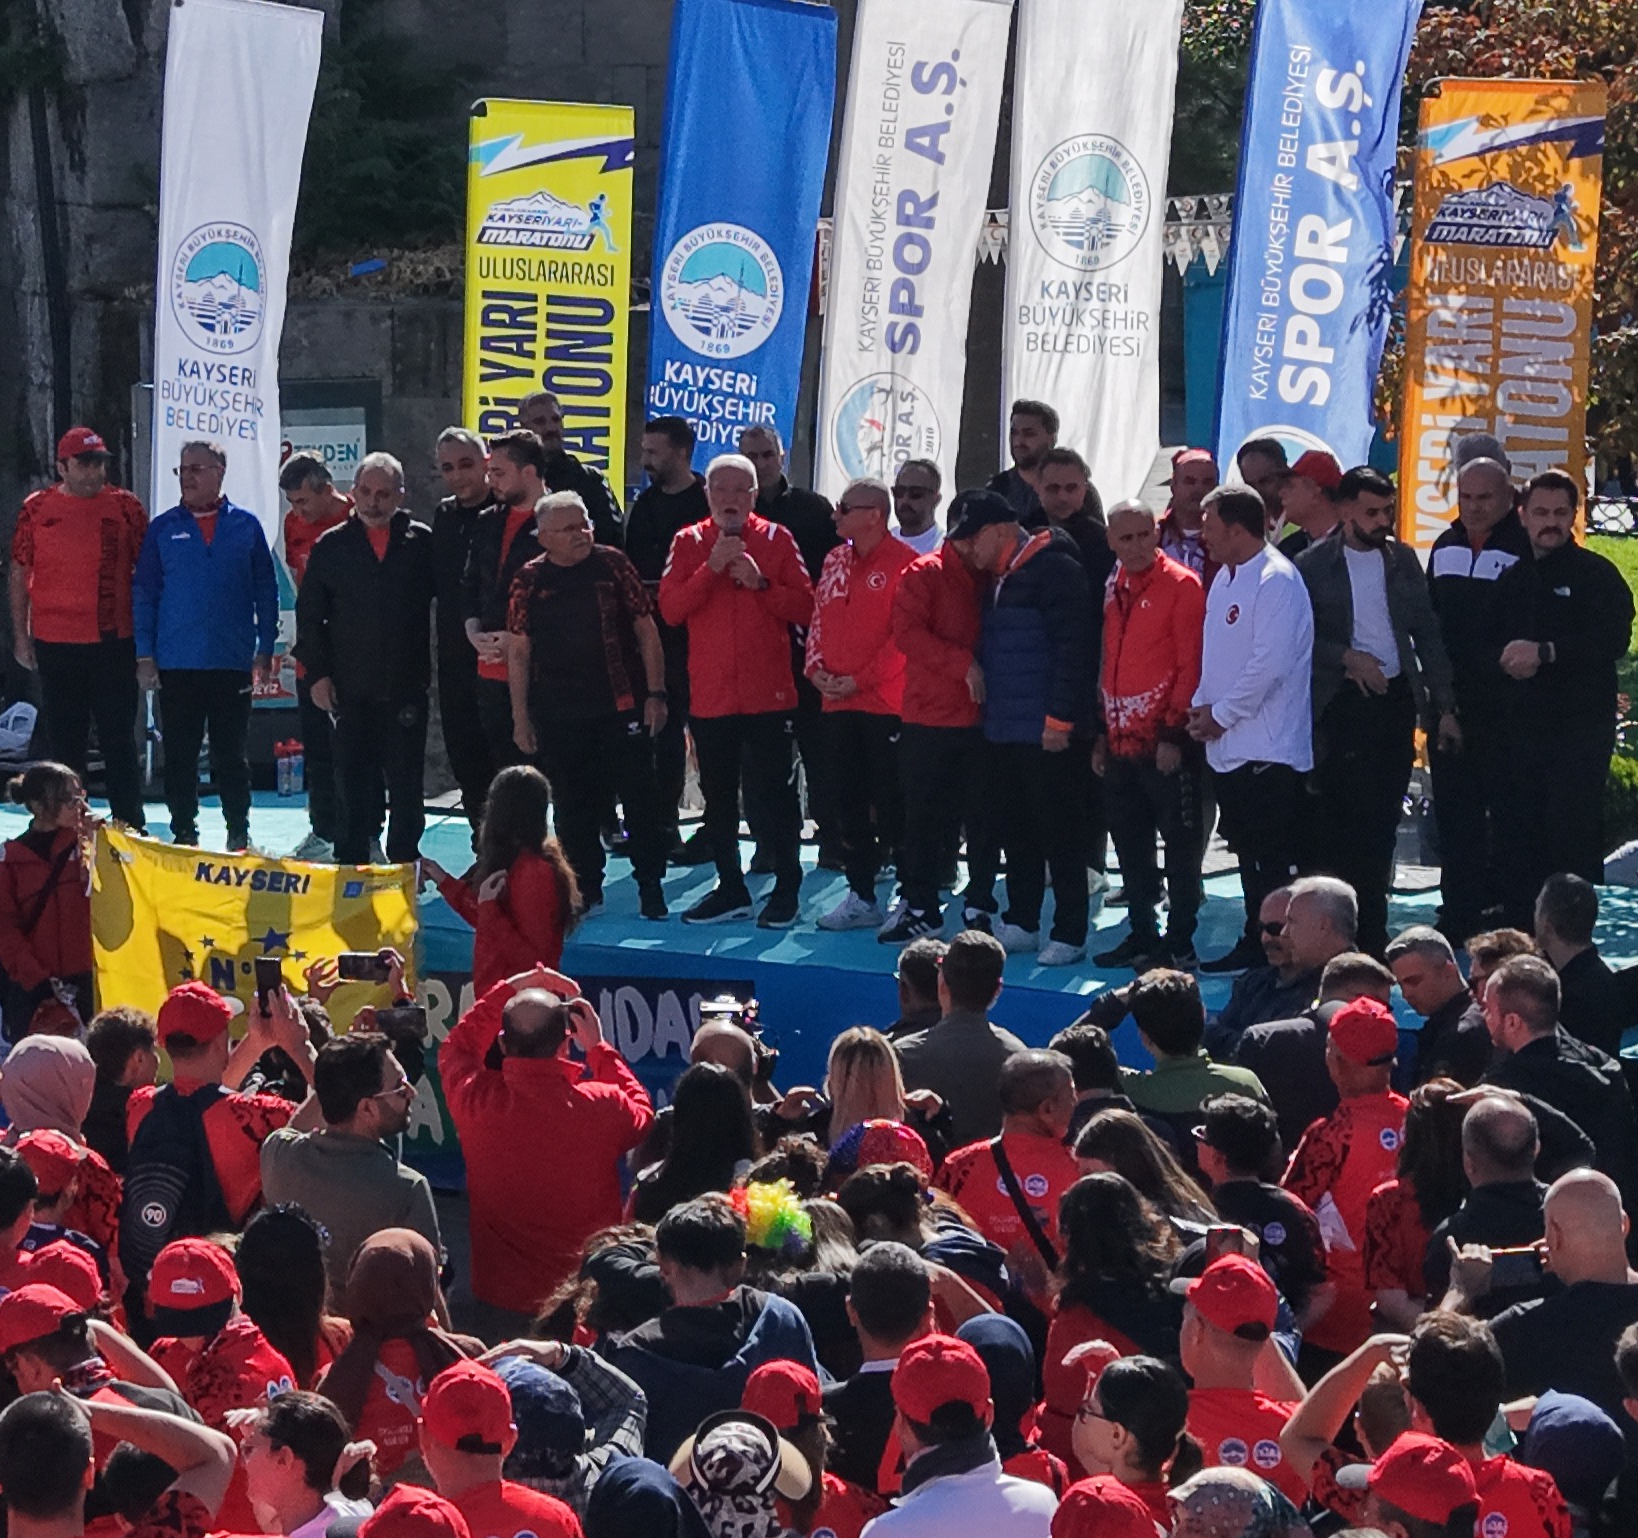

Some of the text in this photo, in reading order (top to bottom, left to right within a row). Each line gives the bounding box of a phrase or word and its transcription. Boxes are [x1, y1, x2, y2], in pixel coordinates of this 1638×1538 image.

[859, 41, 907, 353] KAYSERİ BÜYÜKŞEHİR BELEDİYESİ
[885, 48, 968, 355] SPOR A.Ş.
[1250, 44, 1311, 401] KAYSERİ BÜYÜKŞEHİR BELEDİYESİ
[1278, 59, 1373, 406] SPOR A.Ş.
[479, 256, 616, 287] ULUSLARARASI
[1040, 278, 1129, 303] KAYSERİ
[1018, 301, 1151, 332] BÜYÜKŞEHİR
[479, 290, 540, 383] YARI
[699, 339, 731, 354] 1869
[1025, 331, 1142, 358] BELEDİYESİ
[177, 357, 257, 388] KAYSERİ
[664, 359, 758, 396] KAYSERİ
